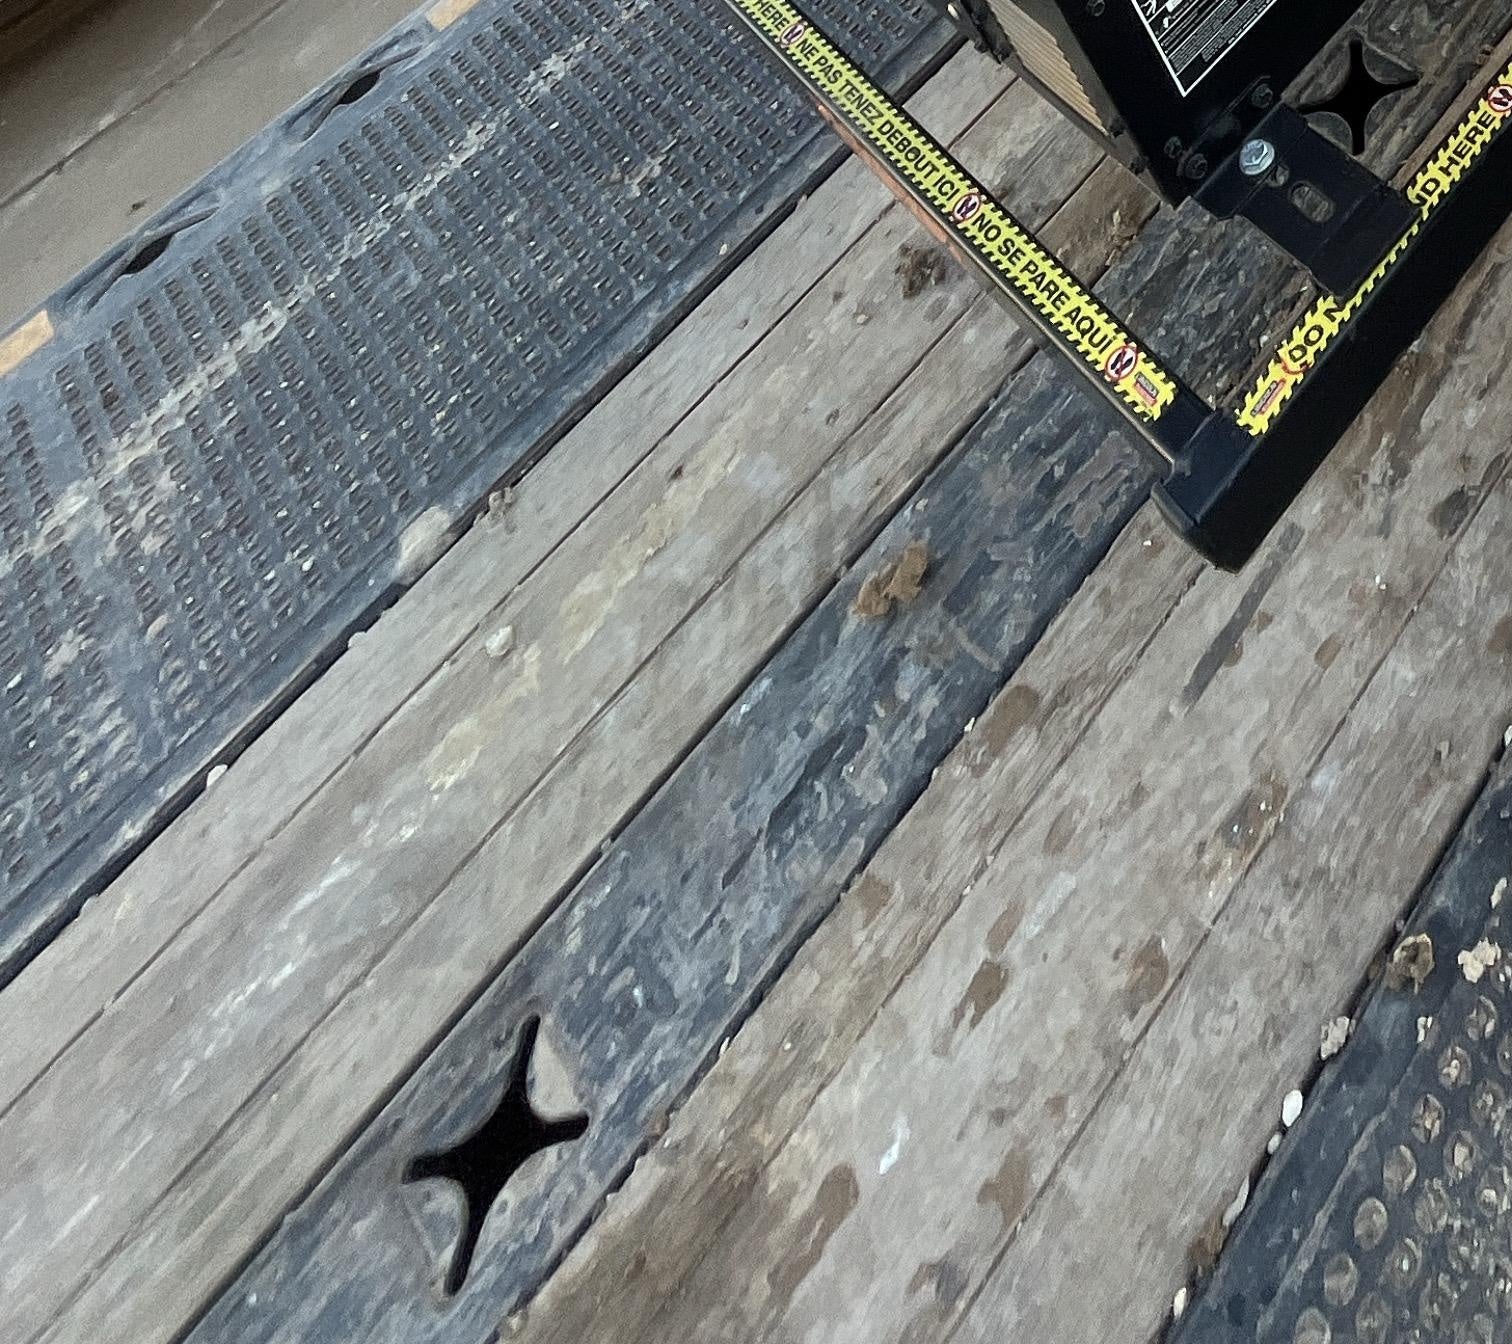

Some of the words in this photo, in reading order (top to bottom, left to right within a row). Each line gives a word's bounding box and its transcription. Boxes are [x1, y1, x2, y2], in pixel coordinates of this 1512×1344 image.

[795, 38, 819, 62] NE
[812, 55, 843, 85] PAS
[838, 79, 884, 126] TENEZ
[876, 119, 940, 180] DEBOUT
[932, 174, 961, 202] ICI
[971, 212, 1001, 242] NO
[997, 238, 1026, 266] SE
[1019, 259, 1071, 311] PARE
[1288, 324, 1324, 363] DO
[1439, 109, 1497, 176] HERE
